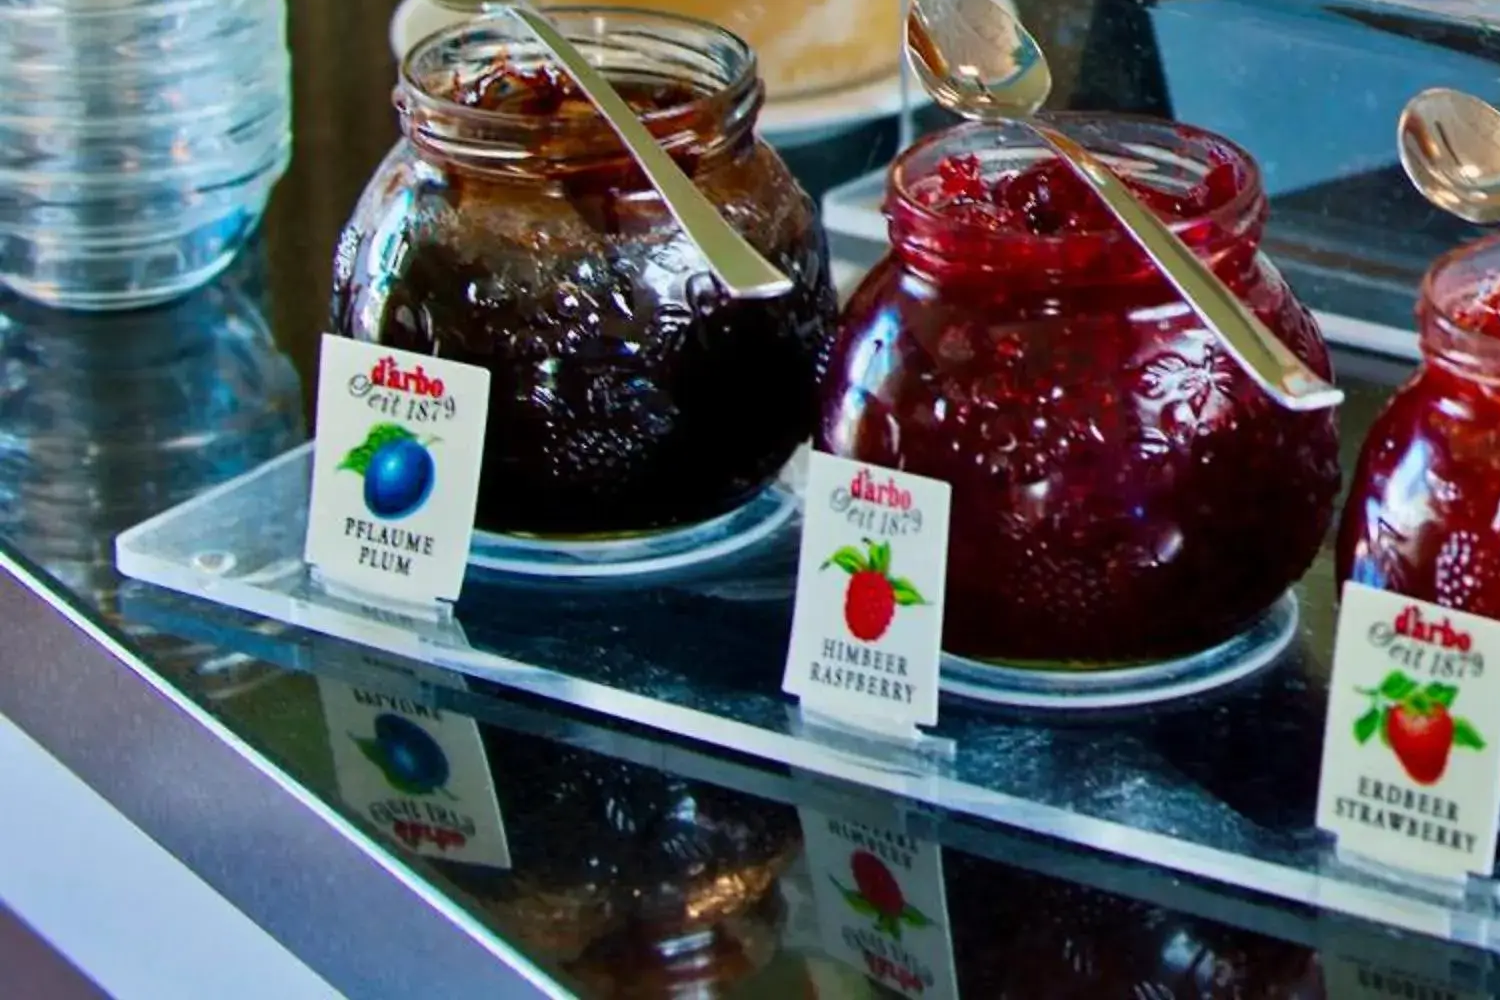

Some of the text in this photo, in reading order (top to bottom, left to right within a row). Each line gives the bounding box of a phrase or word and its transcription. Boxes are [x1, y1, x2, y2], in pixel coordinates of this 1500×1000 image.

[349, 373, 455, 422] Seit 1879
[829, 487, 922, 537] Seit 1879
[345, 517, 435, 555] PFLAUME
[358, 547, 411, 576] PLUM
[822, 637, 908, 676] HIMBEER
[1367, 621, 1484, 679] Seit 1879
[809, 662, 917, 704] RASPBERRY
[1358, 776, 1460, 822] ERDBEER
[1334, 797, 1479, 854] STRAWBERRY
